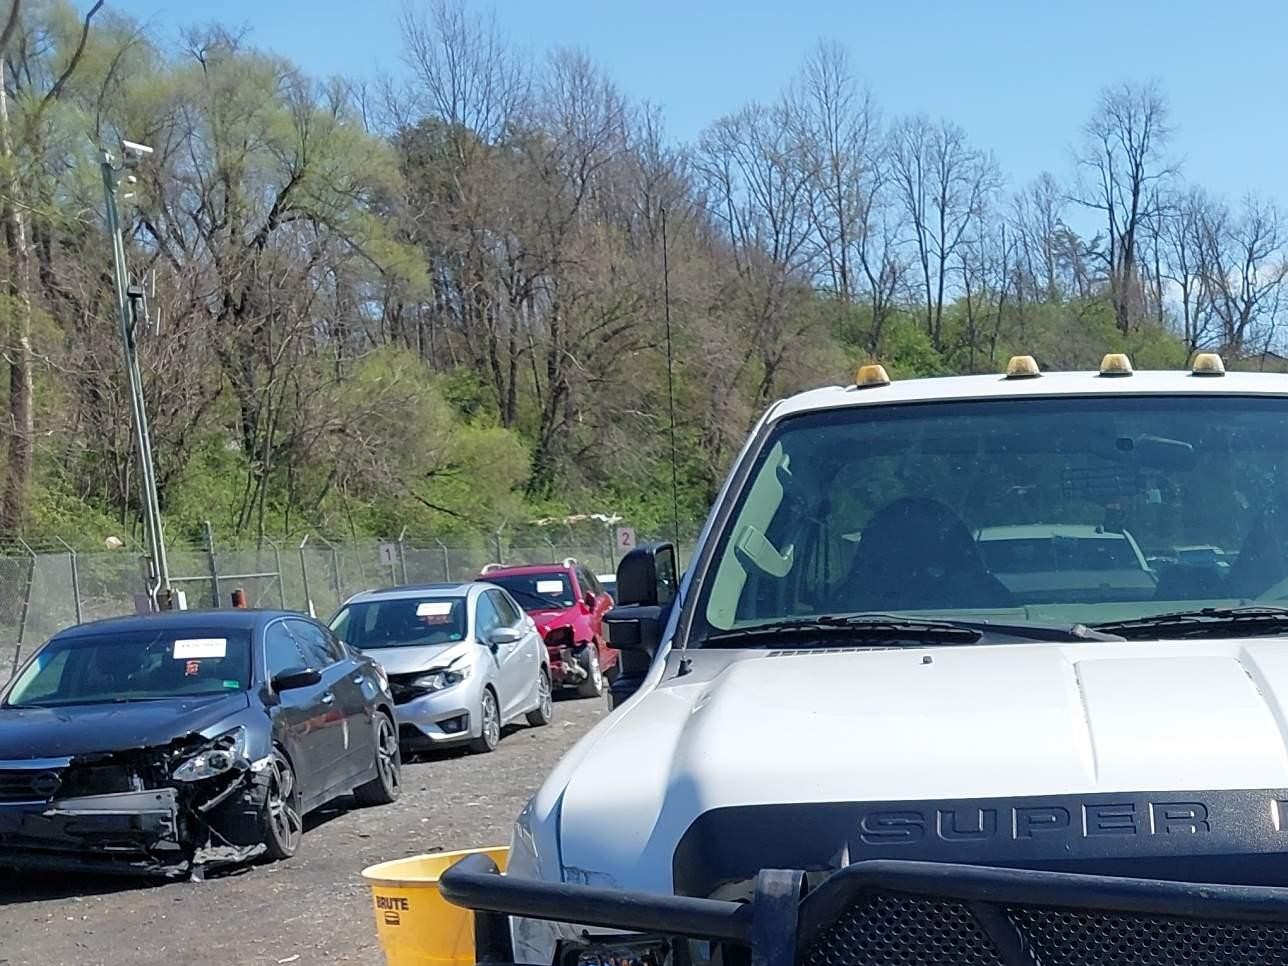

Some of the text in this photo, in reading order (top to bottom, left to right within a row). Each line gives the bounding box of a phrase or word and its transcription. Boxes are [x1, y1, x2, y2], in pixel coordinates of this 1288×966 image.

[621, 531, 631, 546] 2
[385, 548, 392, 561] 1
[859, 800, 1212, 846] SUPER
[376, 896, 409, 911] BRUTE
